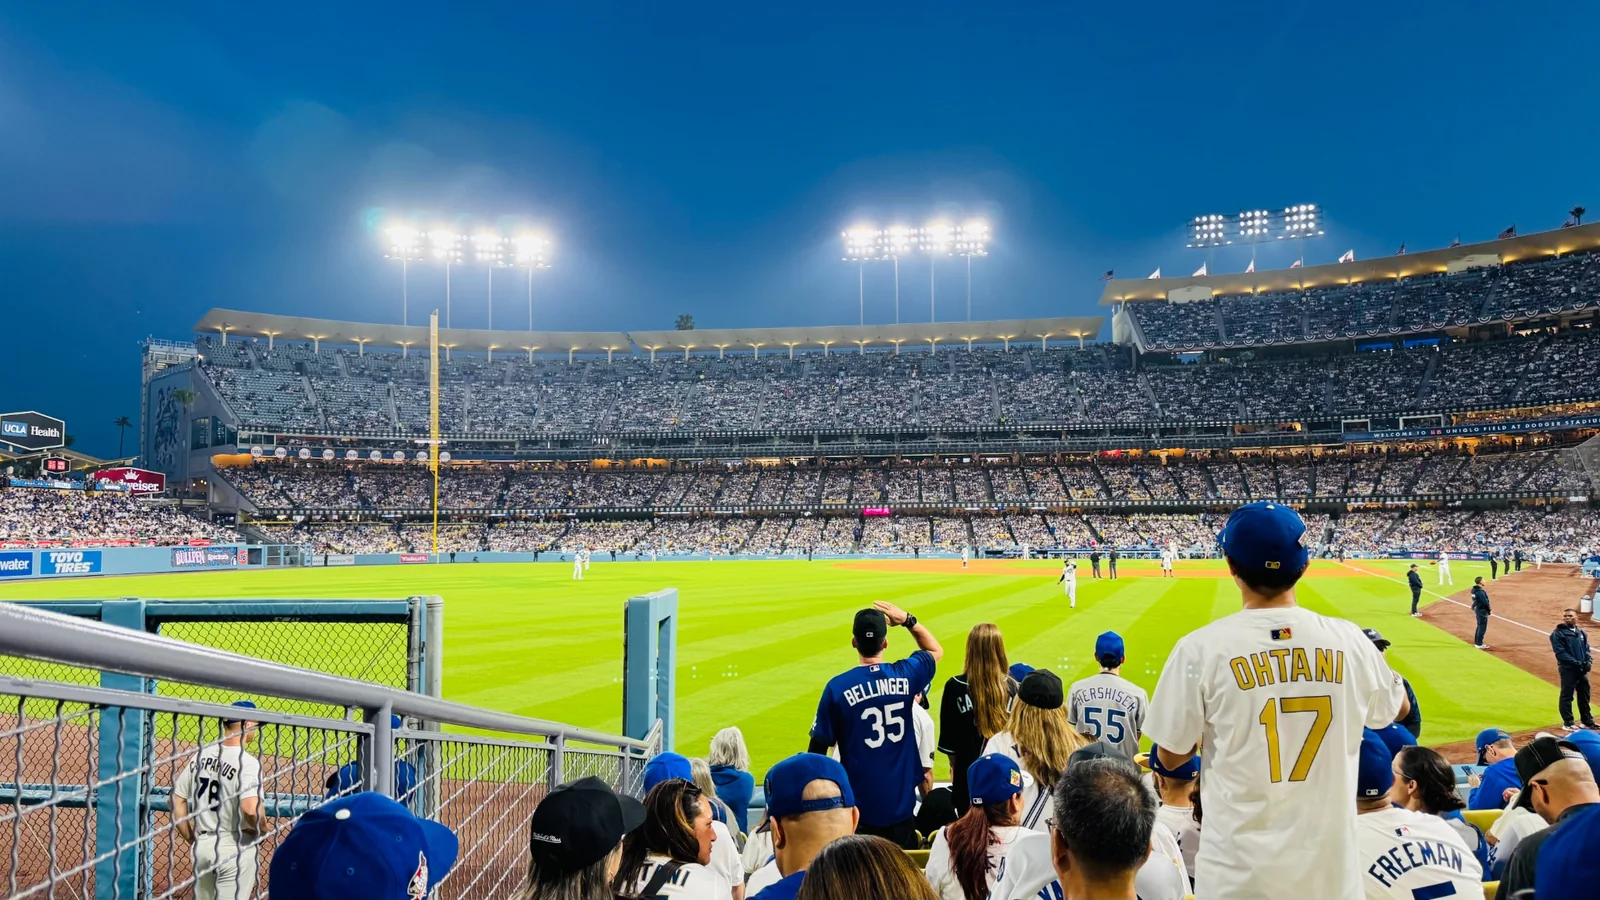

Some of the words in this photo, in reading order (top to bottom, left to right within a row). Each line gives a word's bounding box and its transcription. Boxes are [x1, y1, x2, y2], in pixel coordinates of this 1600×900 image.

[4, 423, 26, 434] UCLA
[31, 425, 60, 438] Health
[1525, 421, 1561, 429] DODGER
[1565, 417, 1600, 426] STADIU
[0, 558, 29, 571] water
[50, 552, 83, 563] TOYO
[55, 562, 91, 573] TIRES
[175, 550, 205, 565] BULLPEN
[1230, 648, 1343, 691] OHTANI
[843, 678, 909, 707] BELLINGER
[1076, 687, 1136, 712] HERSHISER
[861, 701, 905, 749] 35
[1084, 706, 1126, 744] 55
[1259, 695, 1332, 783] 17
[190, 757, 237, 780] CSPARUS
[197, 777, 220, 811] 78
[1368, 841, 1462, 888] FREEMAN
